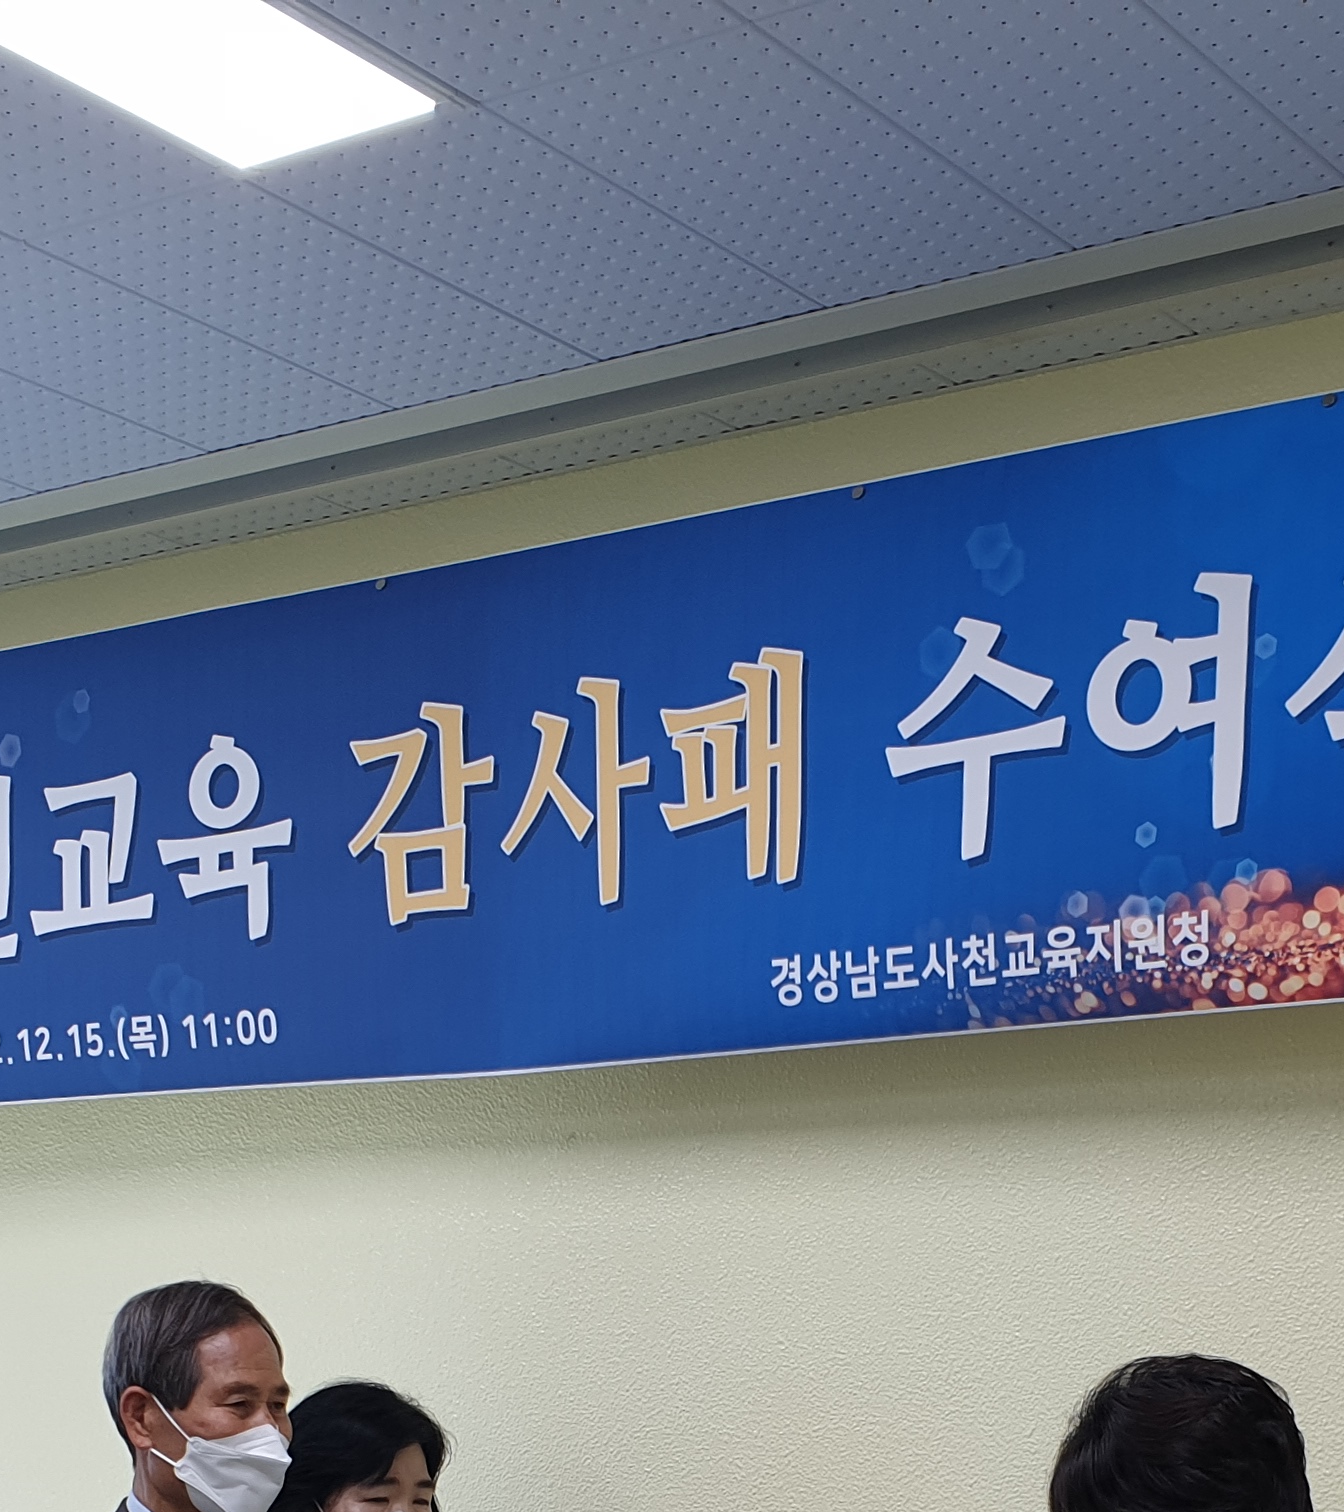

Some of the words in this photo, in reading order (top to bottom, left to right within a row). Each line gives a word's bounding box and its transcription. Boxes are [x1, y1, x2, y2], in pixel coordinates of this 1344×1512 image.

[347, 646, 804, 927] 감사패
[769, 909, 1211, 1008] 경상남도사천교육지원청
[181, 1007, 279, 1050] 11:00
